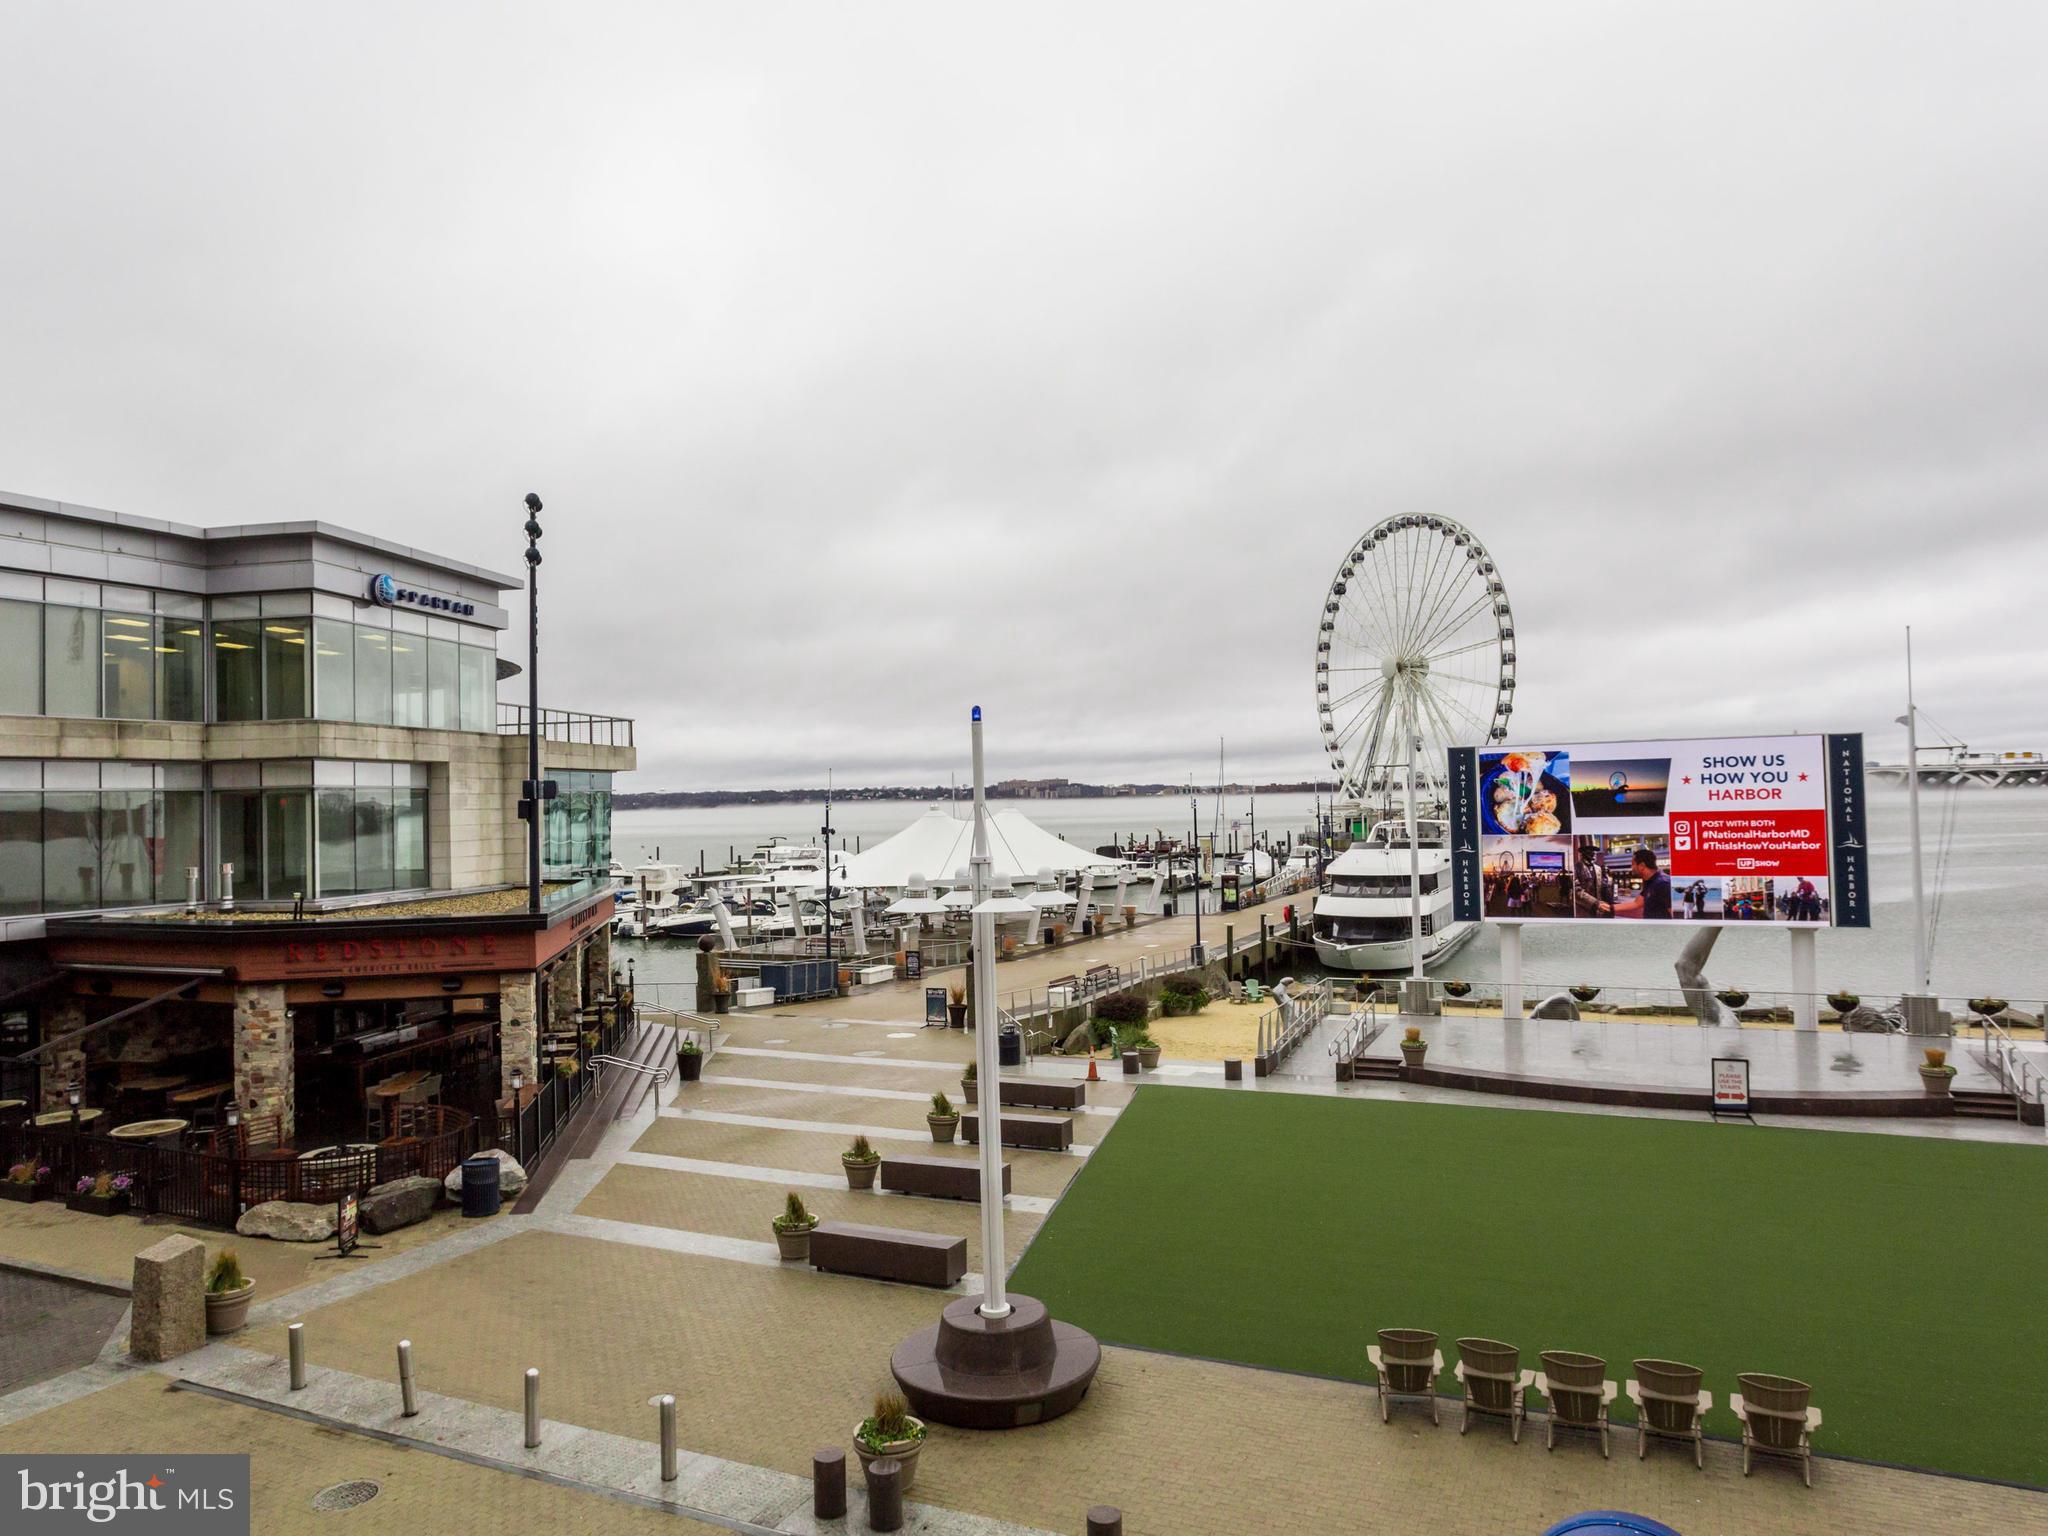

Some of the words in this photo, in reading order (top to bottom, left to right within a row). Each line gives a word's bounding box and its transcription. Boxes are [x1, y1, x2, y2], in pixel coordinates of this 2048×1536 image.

[396, 589, 475, 616] SPARTAN
[1702, 755, 1757, 768] SHOW
[1762, 754, 1785, 767] US
[1700, 772, 1745, 784] HOW
[1750, 771, 1788, 784] YOU
[1842, 750, 1853, 823] NATIONAL
[1459, 765, 1467, 830] NATIONAL
[1708, 788, 1782, 800] HARBOR
[1750, 819, 1775, 827] BOTH
[1702, 830, 1810, 839] #NationalHarborMD
[1703, 842, 1821, 850] #ThisIsHowYouHarbor
[1462, 859, 1470, 906] HARBOR
[1847, 856, 1856, 907] HARBOR
[285, 935, 497, 963] REDSTONE
